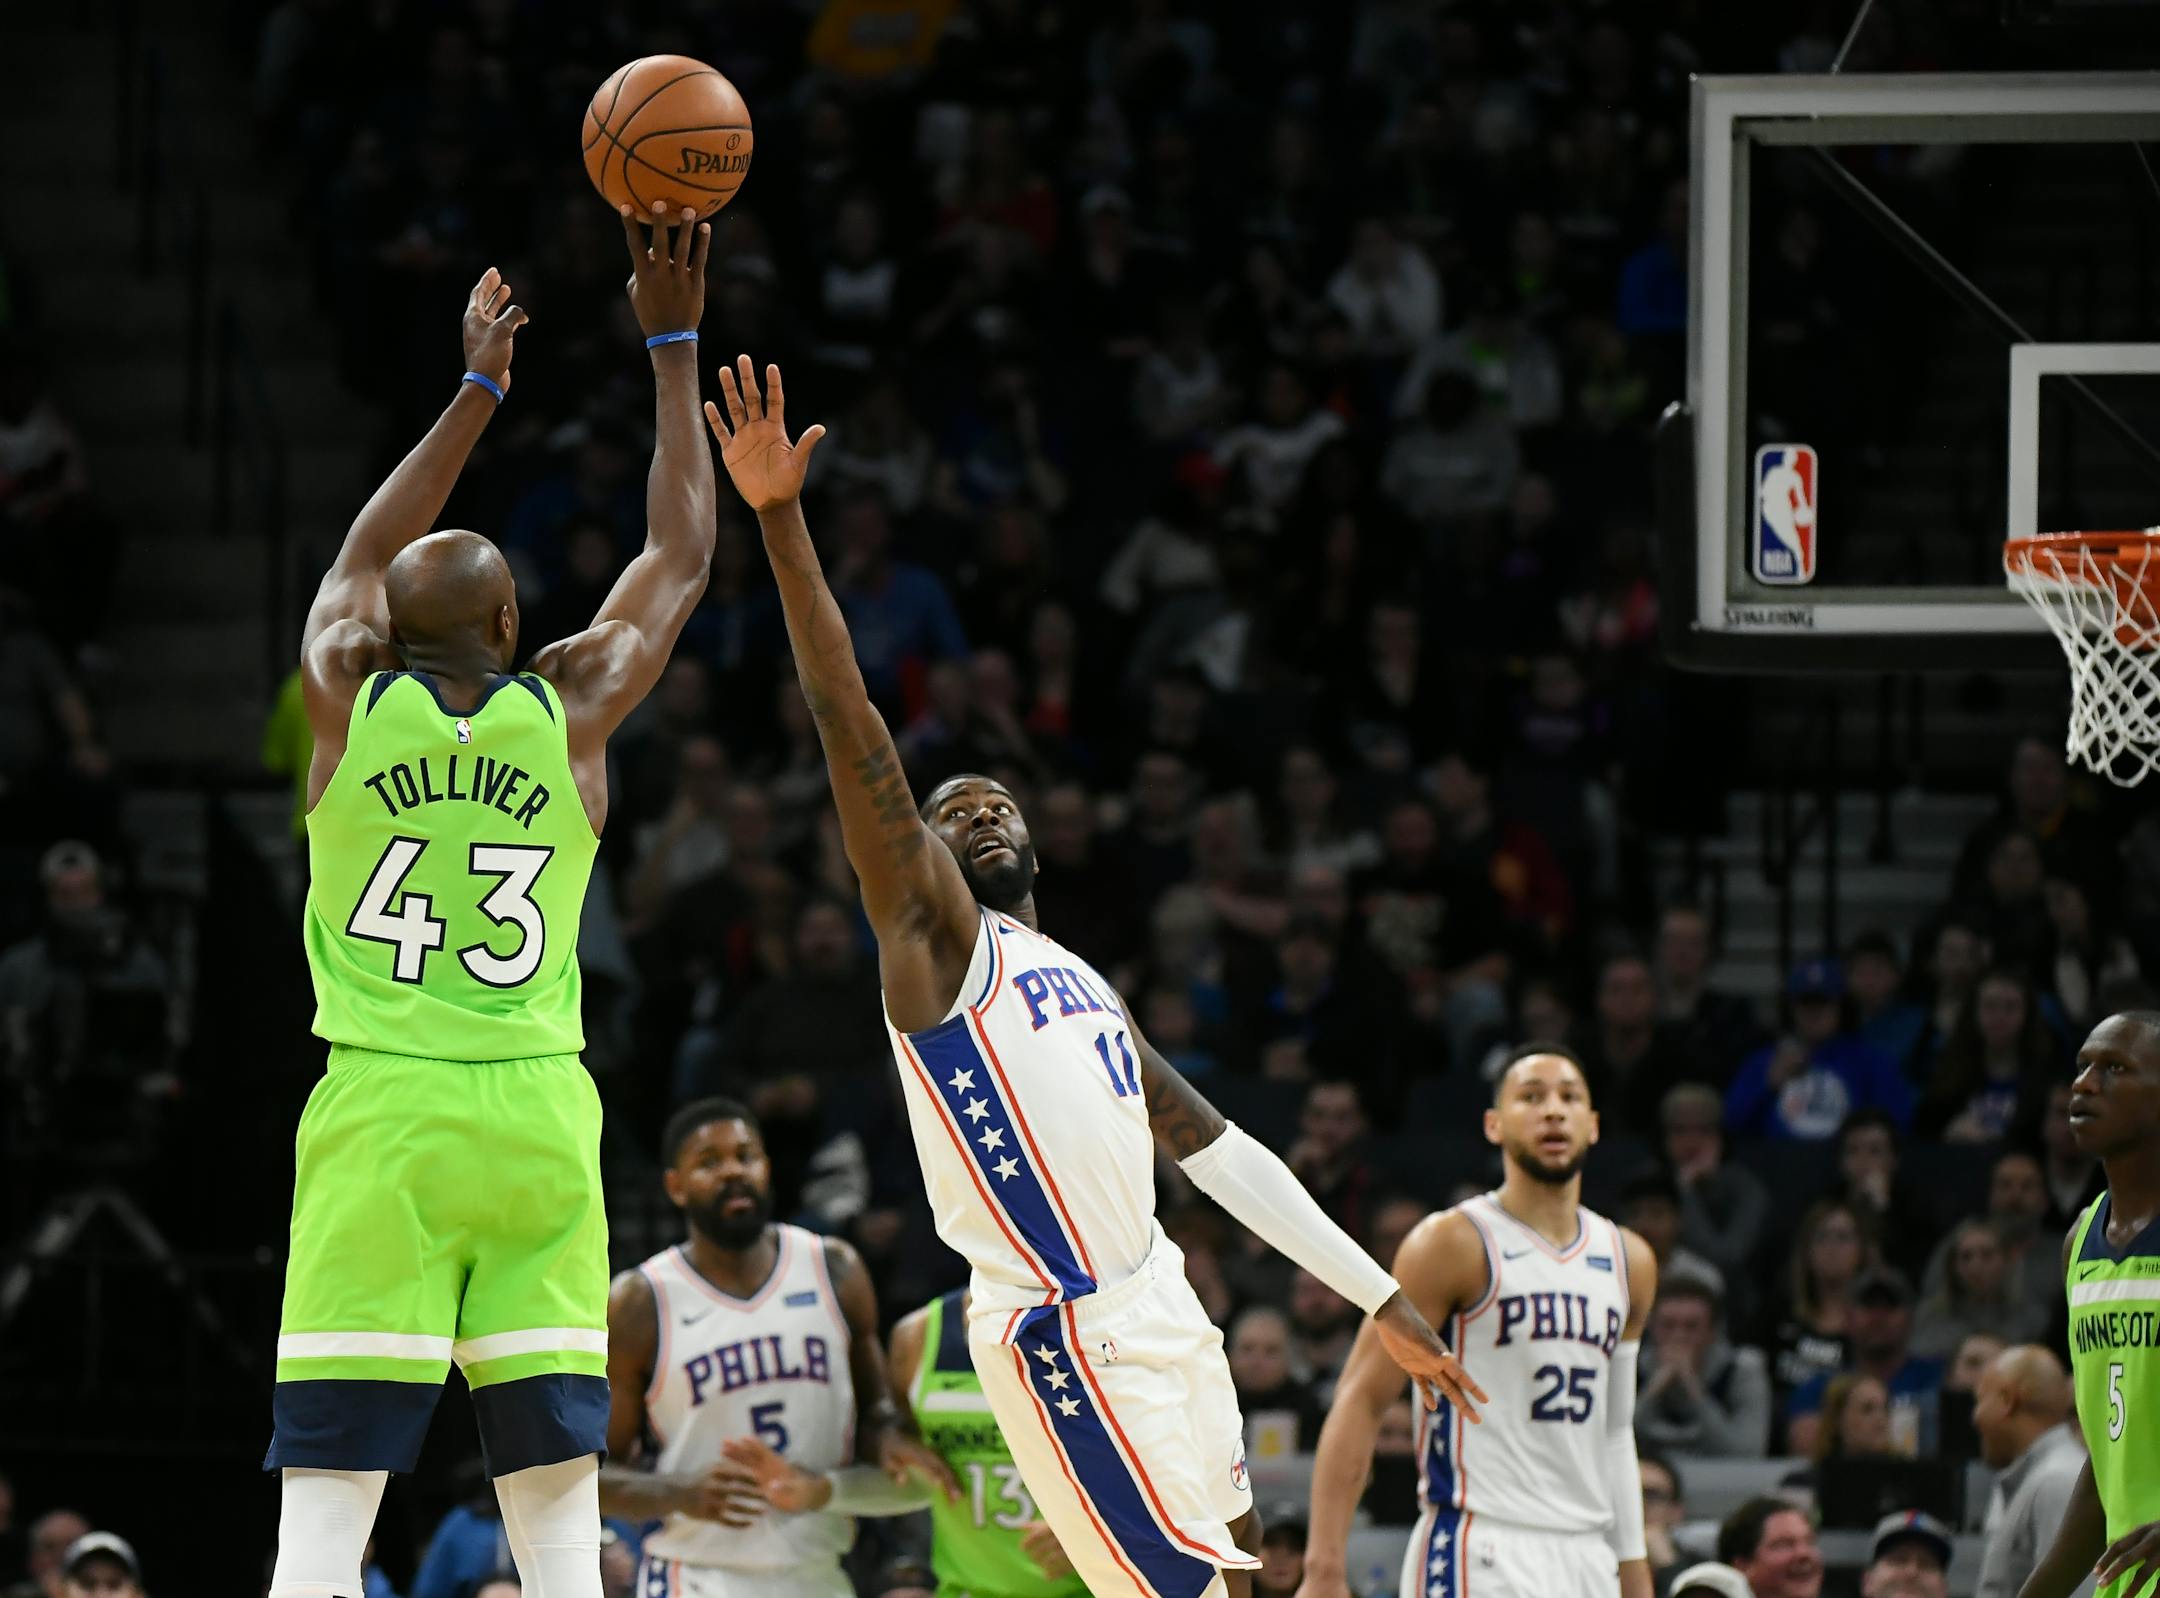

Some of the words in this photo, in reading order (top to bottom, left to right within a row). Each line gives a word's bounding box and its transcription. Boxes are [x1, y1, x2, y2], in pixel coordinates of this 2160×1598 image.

[364, 754, 550, 830] TOLLIVER
[345, 835, 555, 989] 43
[1094, 1031, 1140, 1097] 11
[1531, 1364, 1597, 1422] 25
[2108, 1362, 2125, 1442] 5
[749, 1401, 788, 1453] 5
[966, 1462, 1036, 1528] 13
